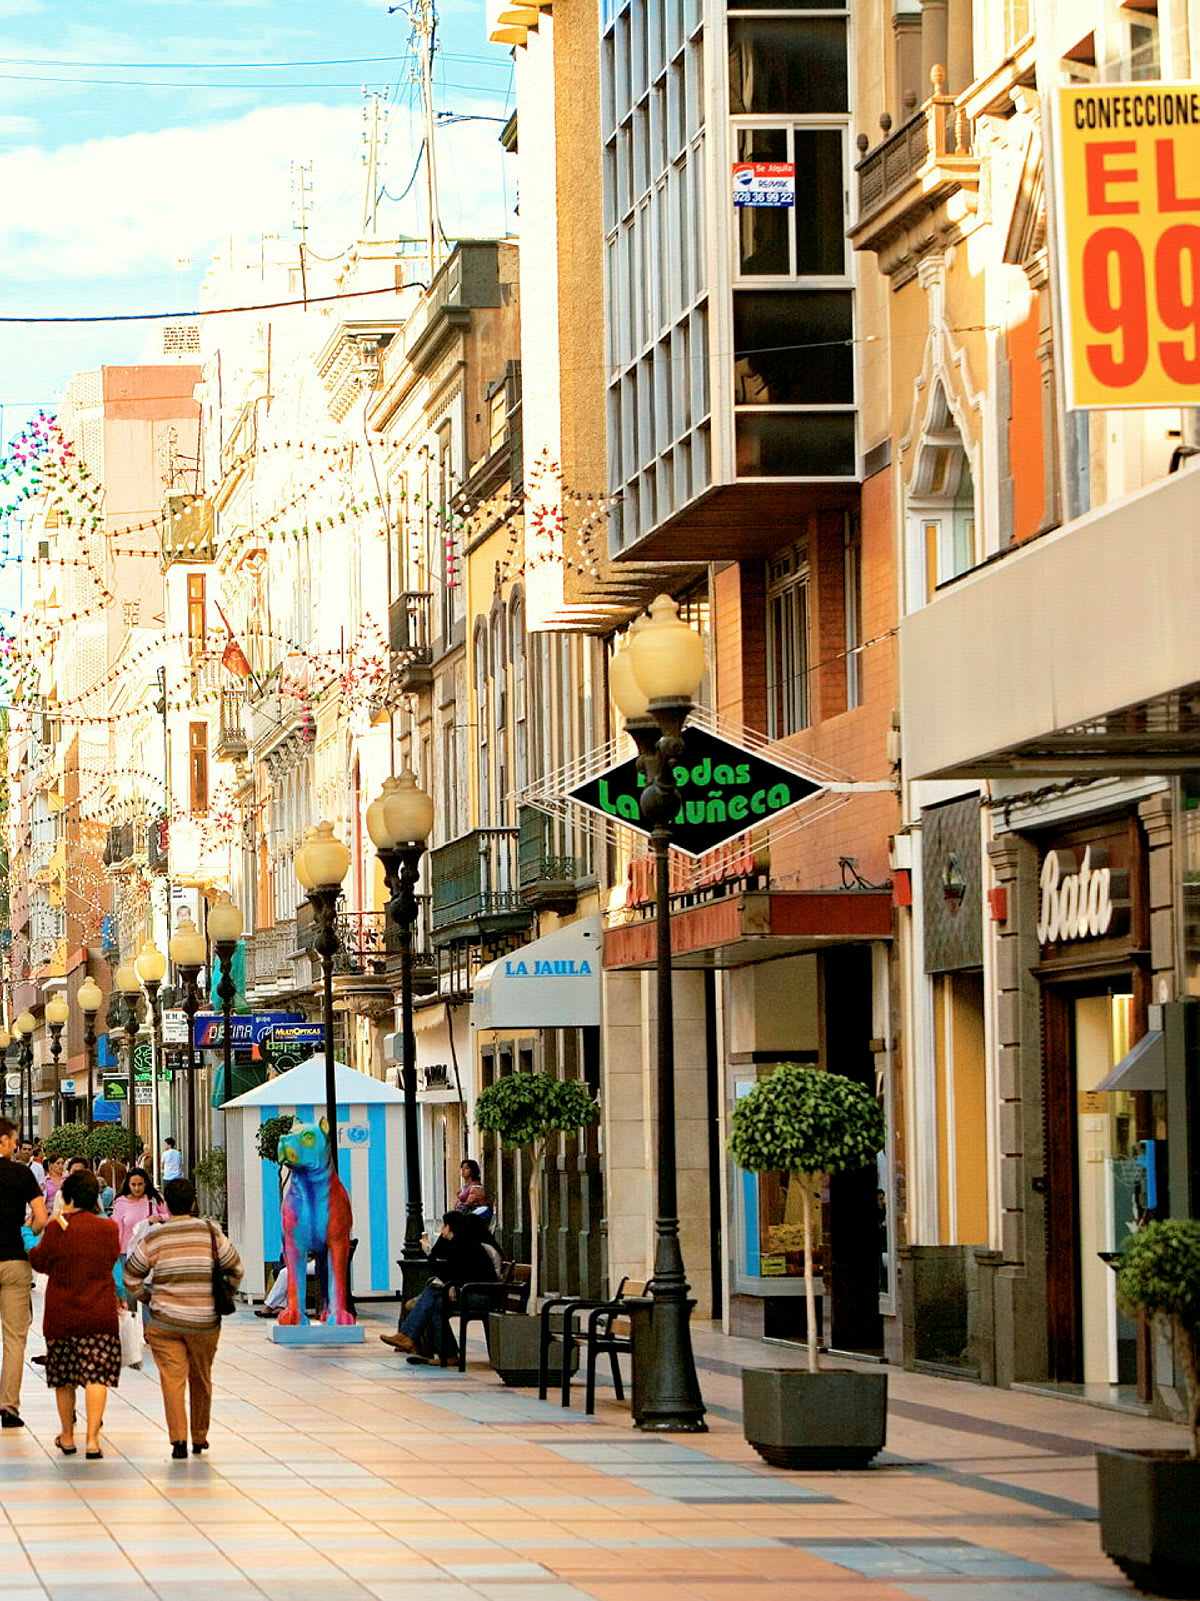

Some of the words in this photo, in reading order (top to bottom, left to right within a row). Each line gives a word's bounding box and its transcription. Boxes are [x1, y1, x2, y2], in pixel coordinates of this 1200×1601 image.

[1075, 94, 1200, 129] CONFECCIONE
[1085, 138, 1200, 216] EL
[780, 194, 793, 202] 22
[637, 758, 750, 788] odas
[598, 778, 640, 821] La
[674, 782, 790, 824] uñeca
[1037, 845, 1113, 945] Bata
[505, 960, 528, 975] LA
[534, 960, 592, 975] JAULA
